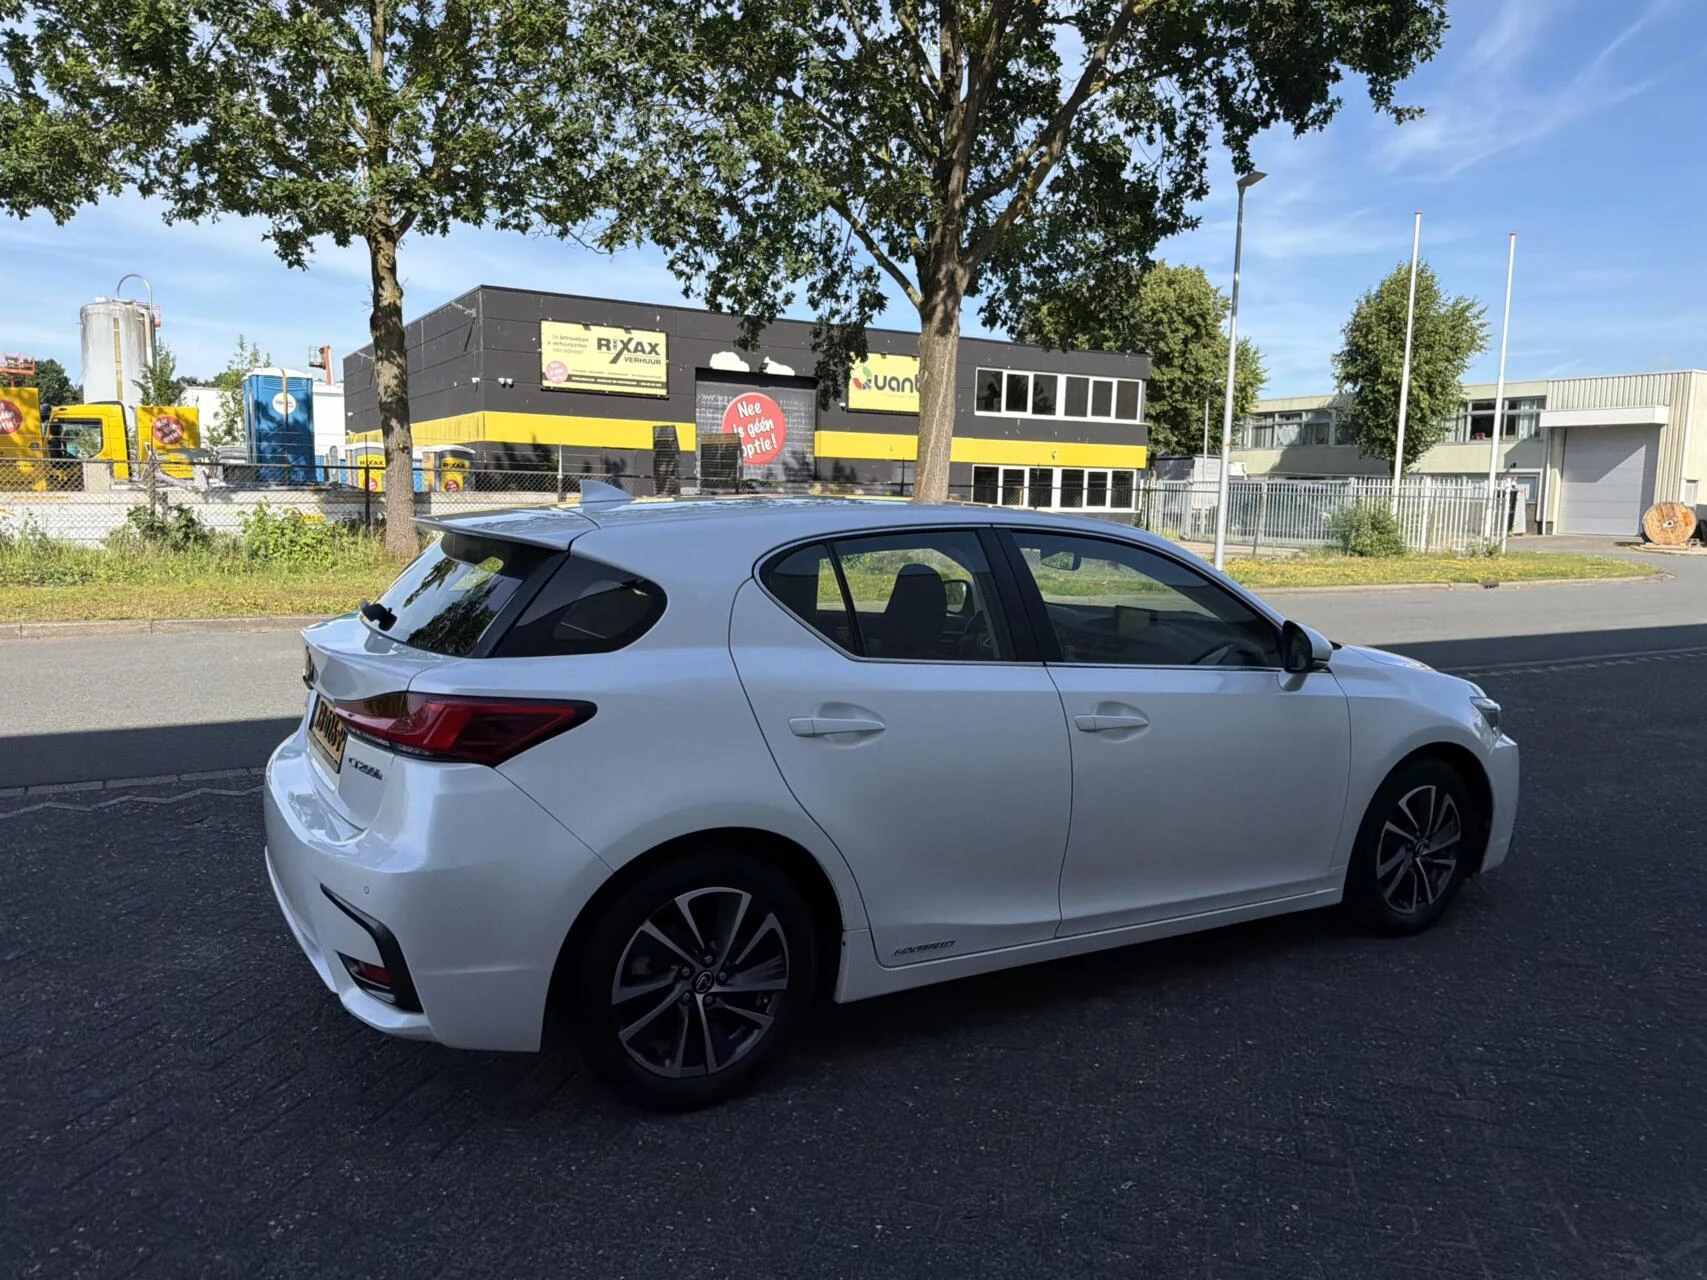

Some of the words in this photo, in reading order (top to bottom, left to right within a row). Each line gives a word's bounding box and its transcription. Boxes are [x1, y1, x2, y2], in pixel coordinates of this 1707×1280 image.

[624, 356, 661, 365] VERHUUR
[737, 400, 762, 418] Nee
[733, 424, 745, 438] is
[747, 417, 774, 438] géén
